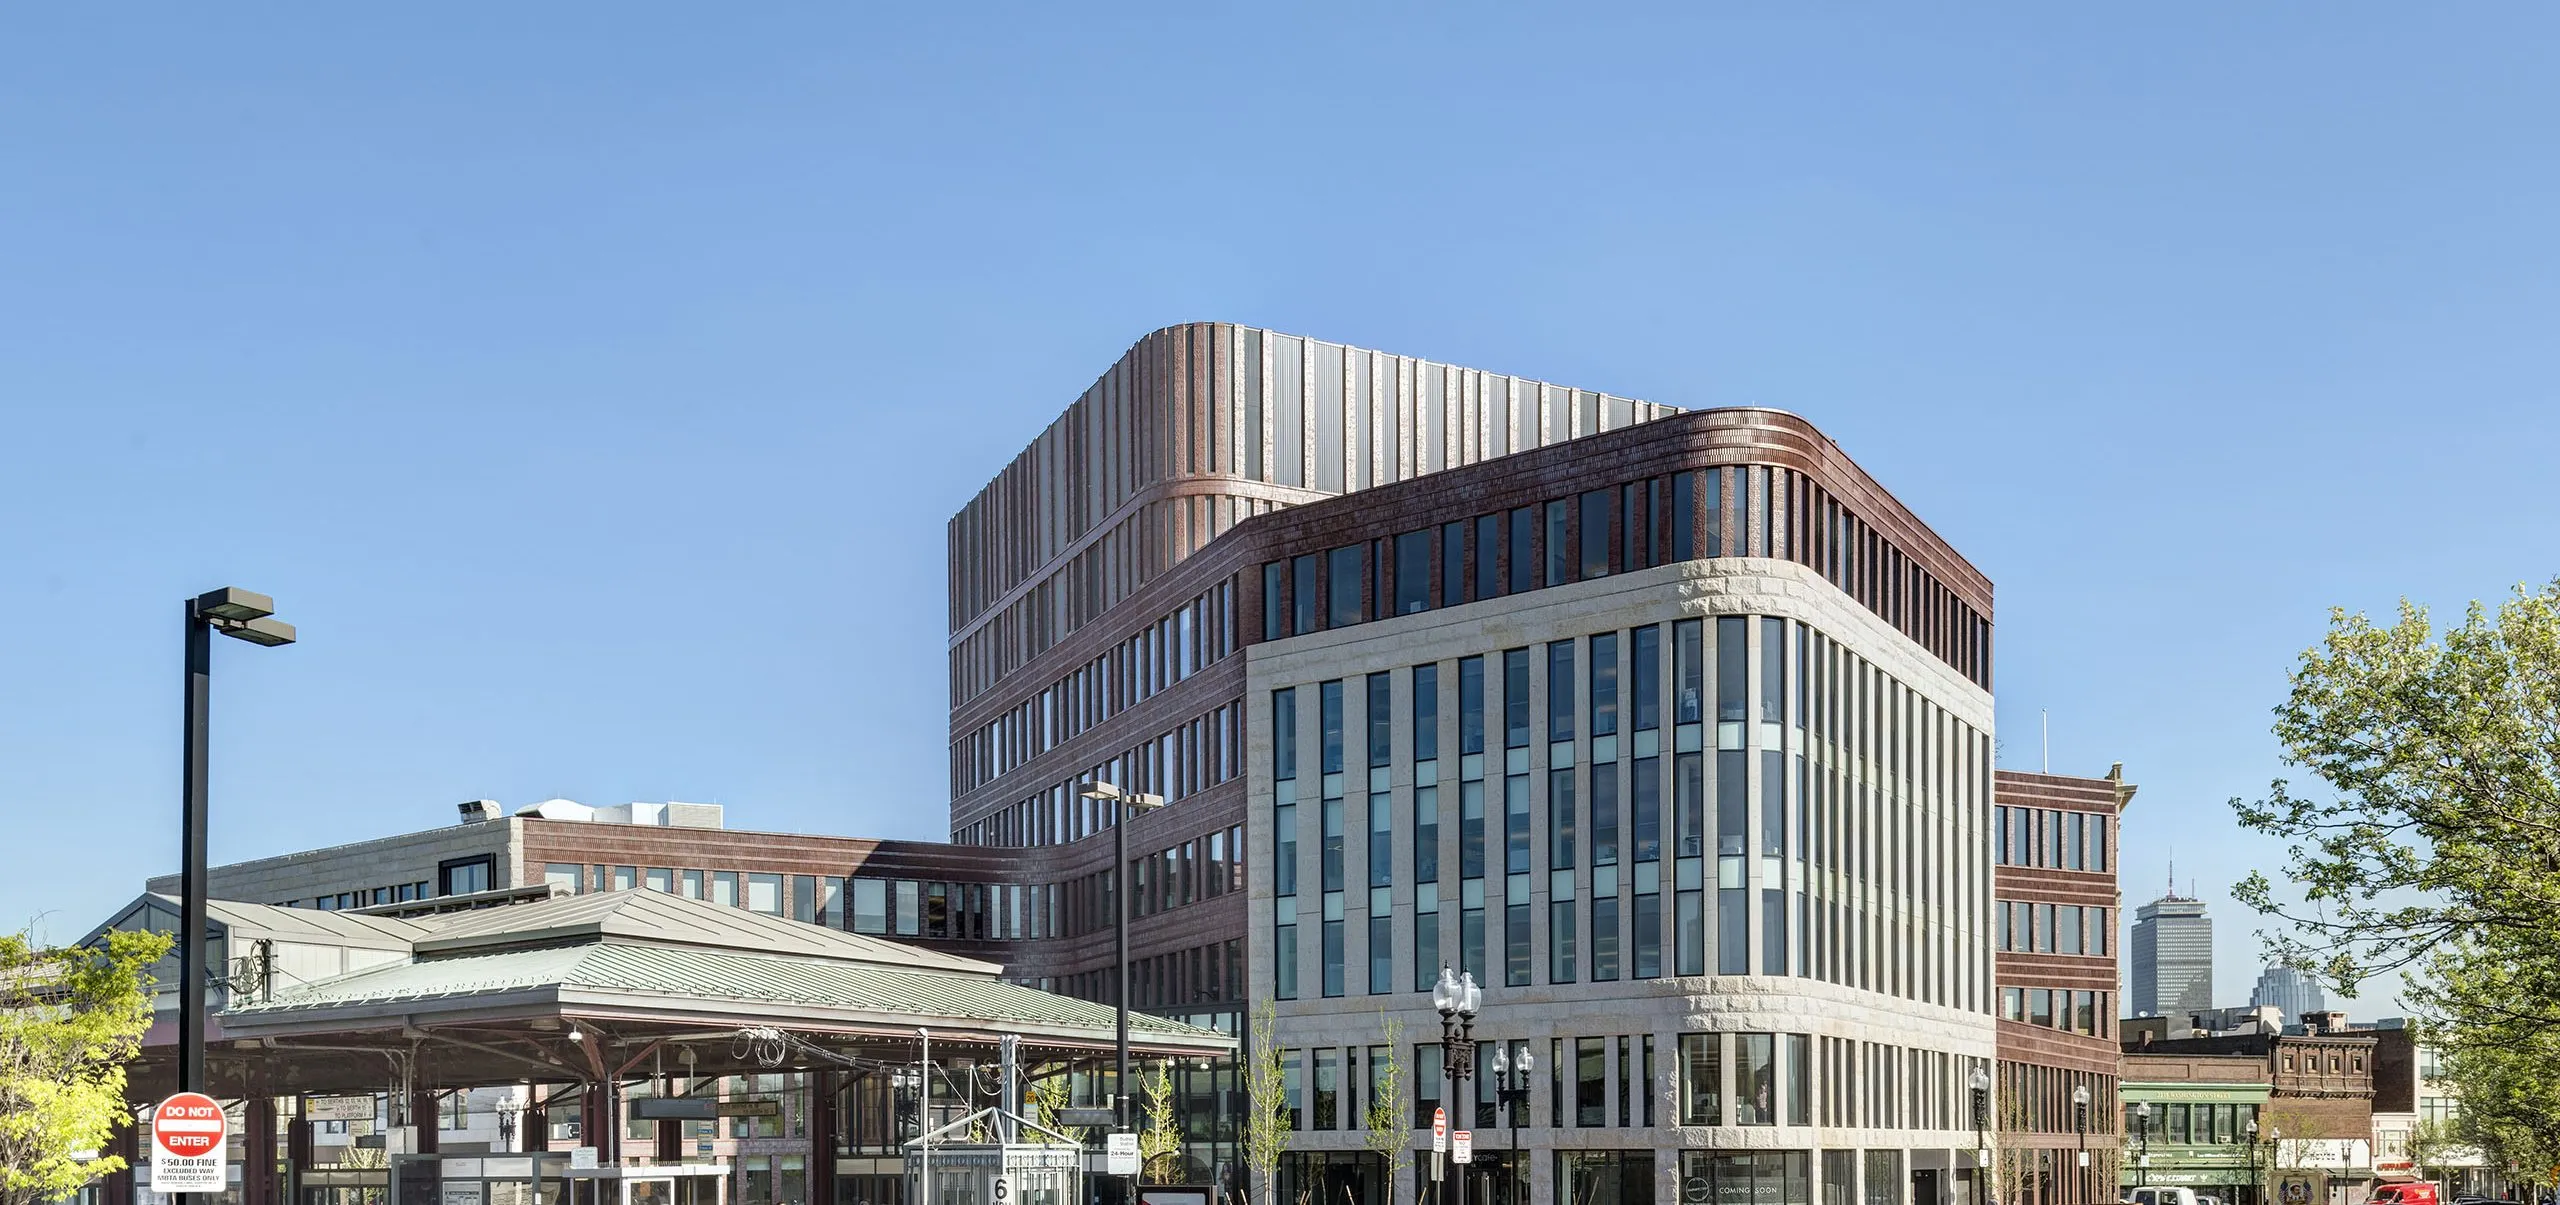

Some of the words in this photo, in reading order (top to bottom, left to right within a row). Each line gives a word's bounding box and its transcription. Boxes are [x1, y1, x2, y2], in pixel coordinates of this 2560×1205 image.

[166, 1106, 185, 1117] DO
[188, 1106, 214, 1117] NOT
[169, 1136, 209, 1146] ENTER
[161, 1158, 194, 1167] $50.00
[197, 1159, 218, 1167] FINE
[995, 1178, 1007, 1200] 6
